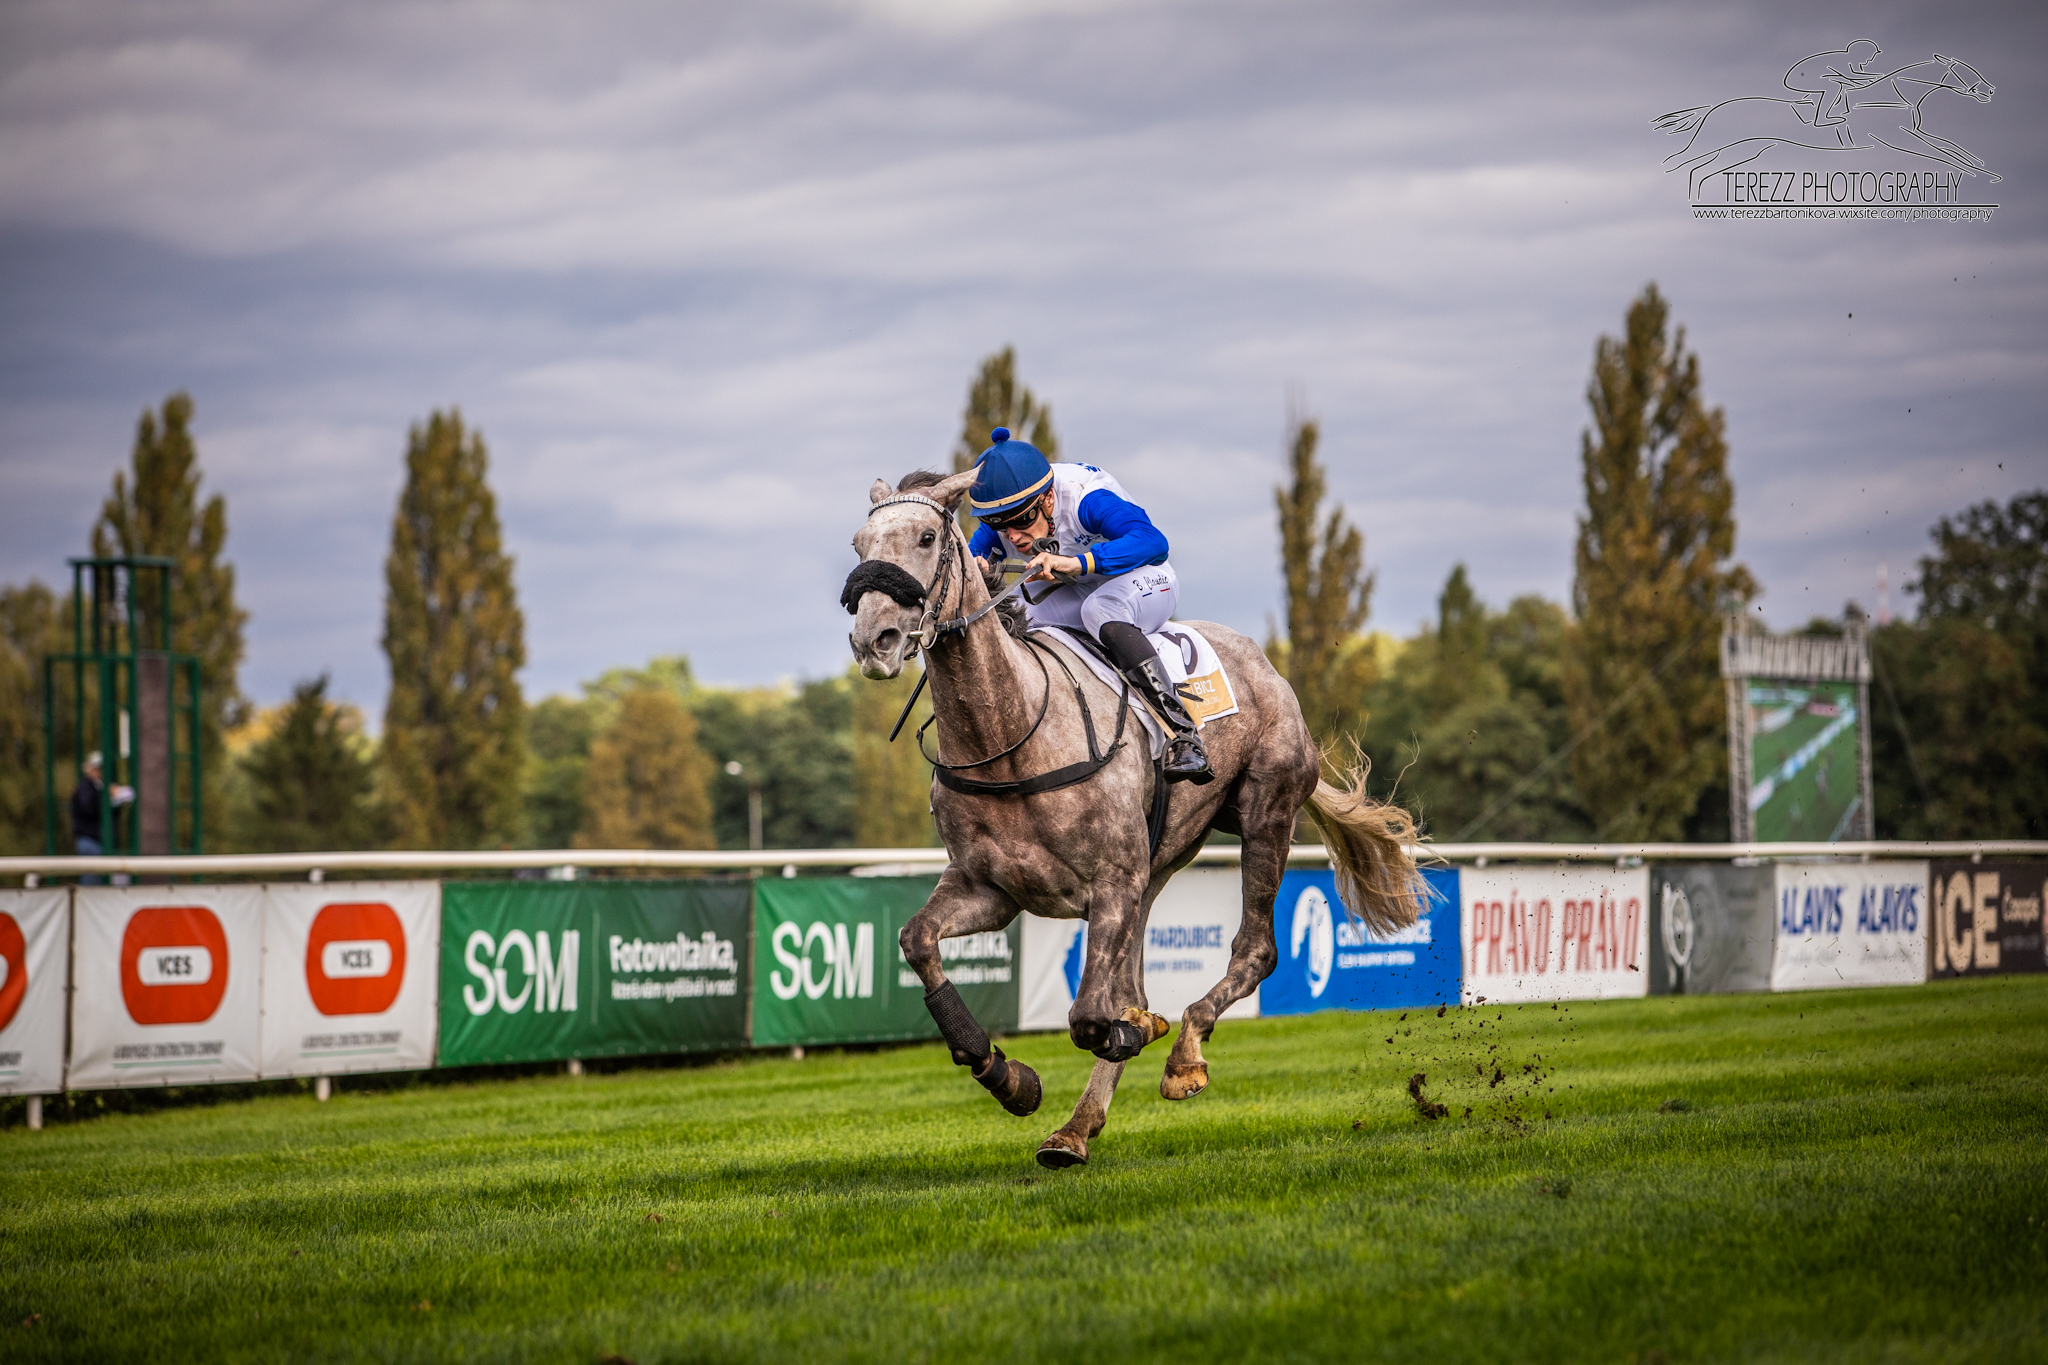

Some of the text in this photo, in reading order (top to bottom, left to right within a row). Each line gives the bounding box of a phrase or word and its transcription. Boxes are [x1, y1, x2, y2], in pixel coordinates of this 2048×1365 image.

[1472, 887, 1640, 975] PRÁVO PRÁVO
[1781, 885, 1844, 934] ALAVIS
[1857, 884, 1919, 934] ALAVIS
